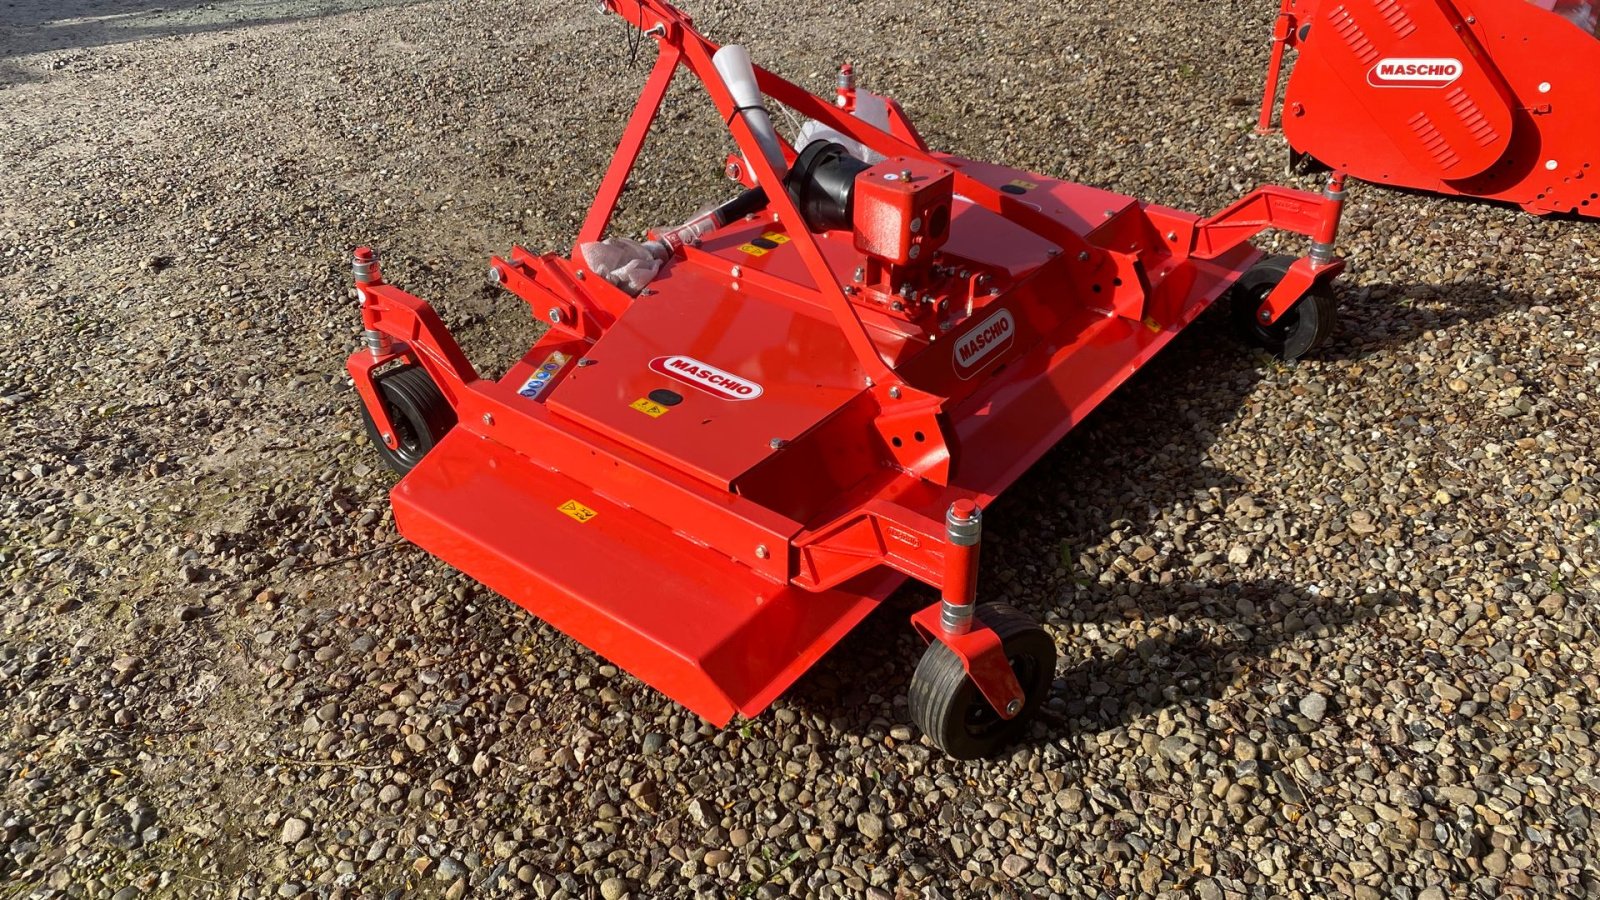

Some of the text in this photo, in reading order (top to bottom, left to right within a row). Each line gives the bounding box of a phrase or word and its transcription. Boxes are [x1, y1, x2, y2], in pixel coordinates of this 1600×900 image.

[1380, 64, 1457, 75] MASCHIO
[958, 317, 1009, 362] MASCHIO
[669, 359, 753, 395] MASCHIO
